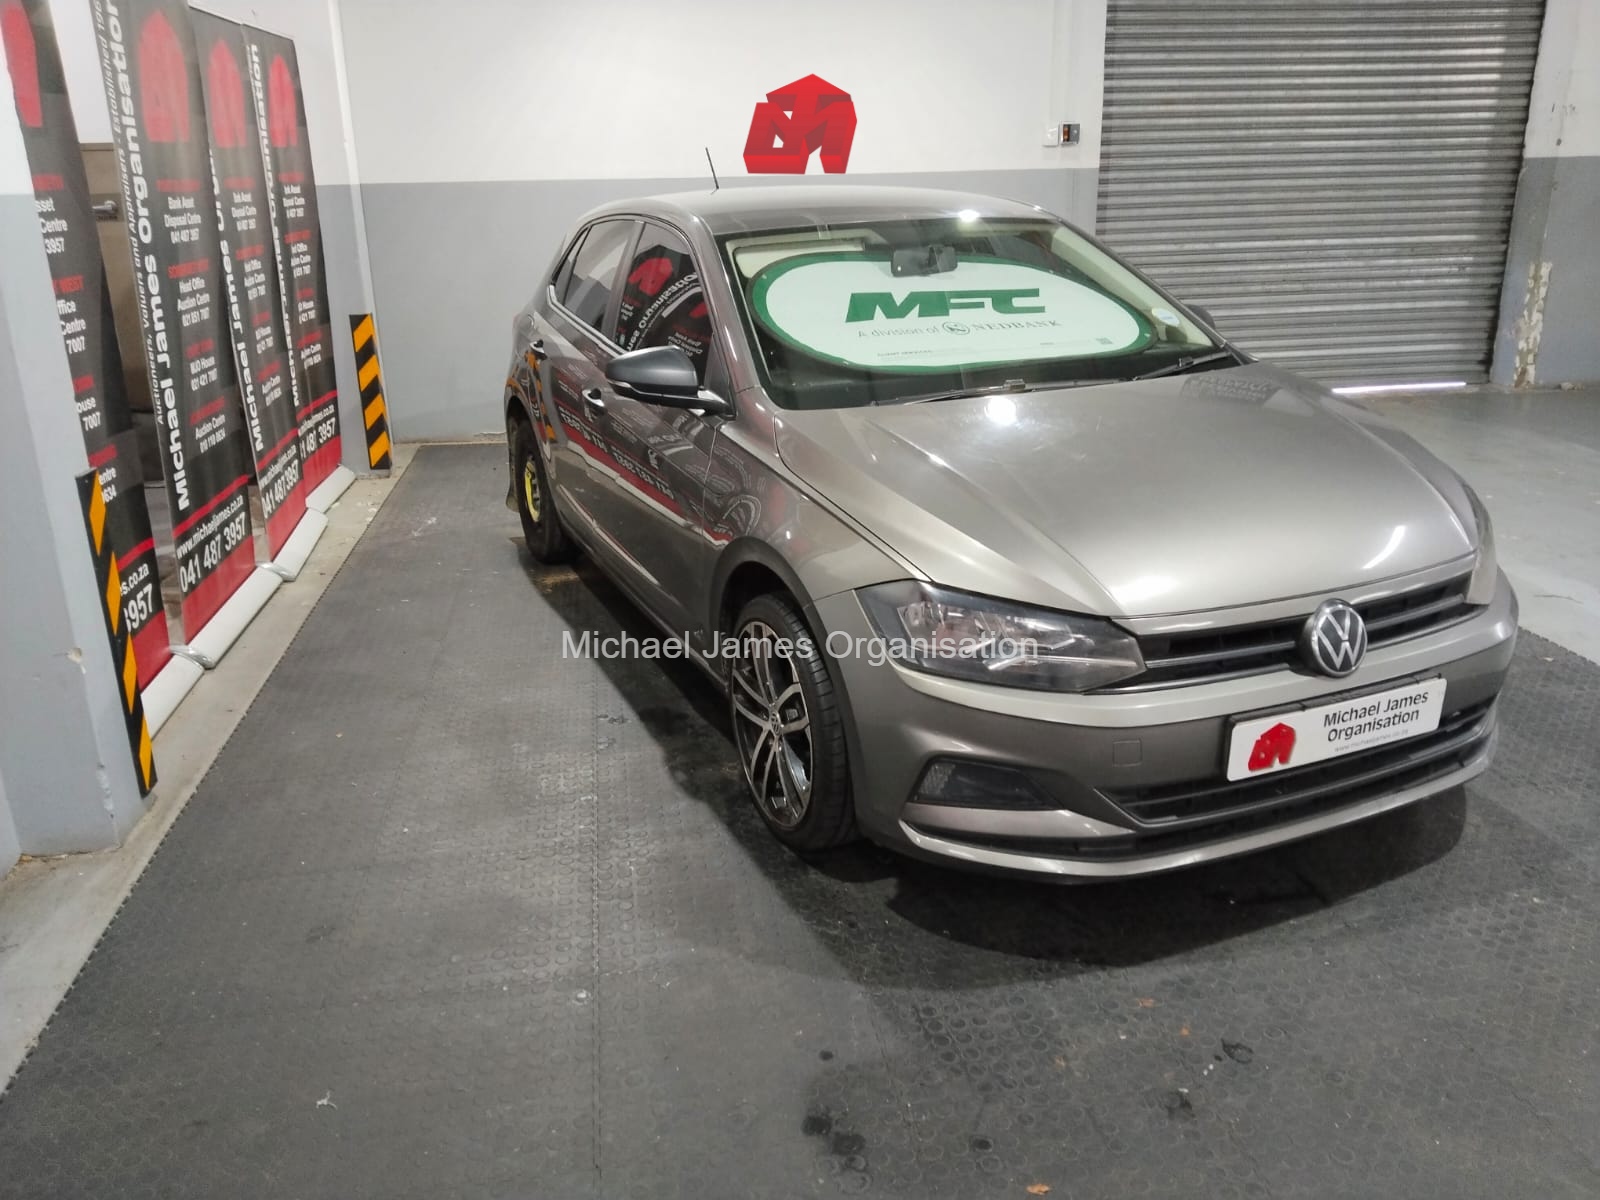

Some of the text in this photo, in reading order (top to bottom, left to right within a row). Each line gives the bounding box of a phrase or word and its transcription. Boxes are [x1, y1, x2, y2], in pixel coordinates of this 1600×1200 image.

[35, 197, 55, 212] sset
[41, 218, 68, 233] Centre
[45, 237, 64, 254] 3957
[130, 236, 141, 268] and
[136, 271, 149, 328] Valuers
[220, 239, 243, 334] James
[57, 299, 76, 314] ffice
[144, 253, 171, 369] James
[845, 288, 1046, 323] MFC
[60, 319, 86, 335] Centre
[871, 327, 924, 337] division
[926, 325, 940, 335] of
[970, 319, 1063, 331] NEDBANK
[76, 397, 96, 413] ouse
[237, 342, 264, 452] Michael
[160, 378, 190, 512] Michael
[318, 416, 336, 444] 3957
[98, 467, 117, 486] entre
[274, 476, 287, 505] 487
[284, 459, 299, 491] 3957
[101, 485, 117, 504] 634
[179, 511, 246, 593] 041 487 3957
[121, 563, 149, 597] s.co.za
[1323, 691, 1429, 728] Michael James
[1327, 709, 1420, 742] Organisation
